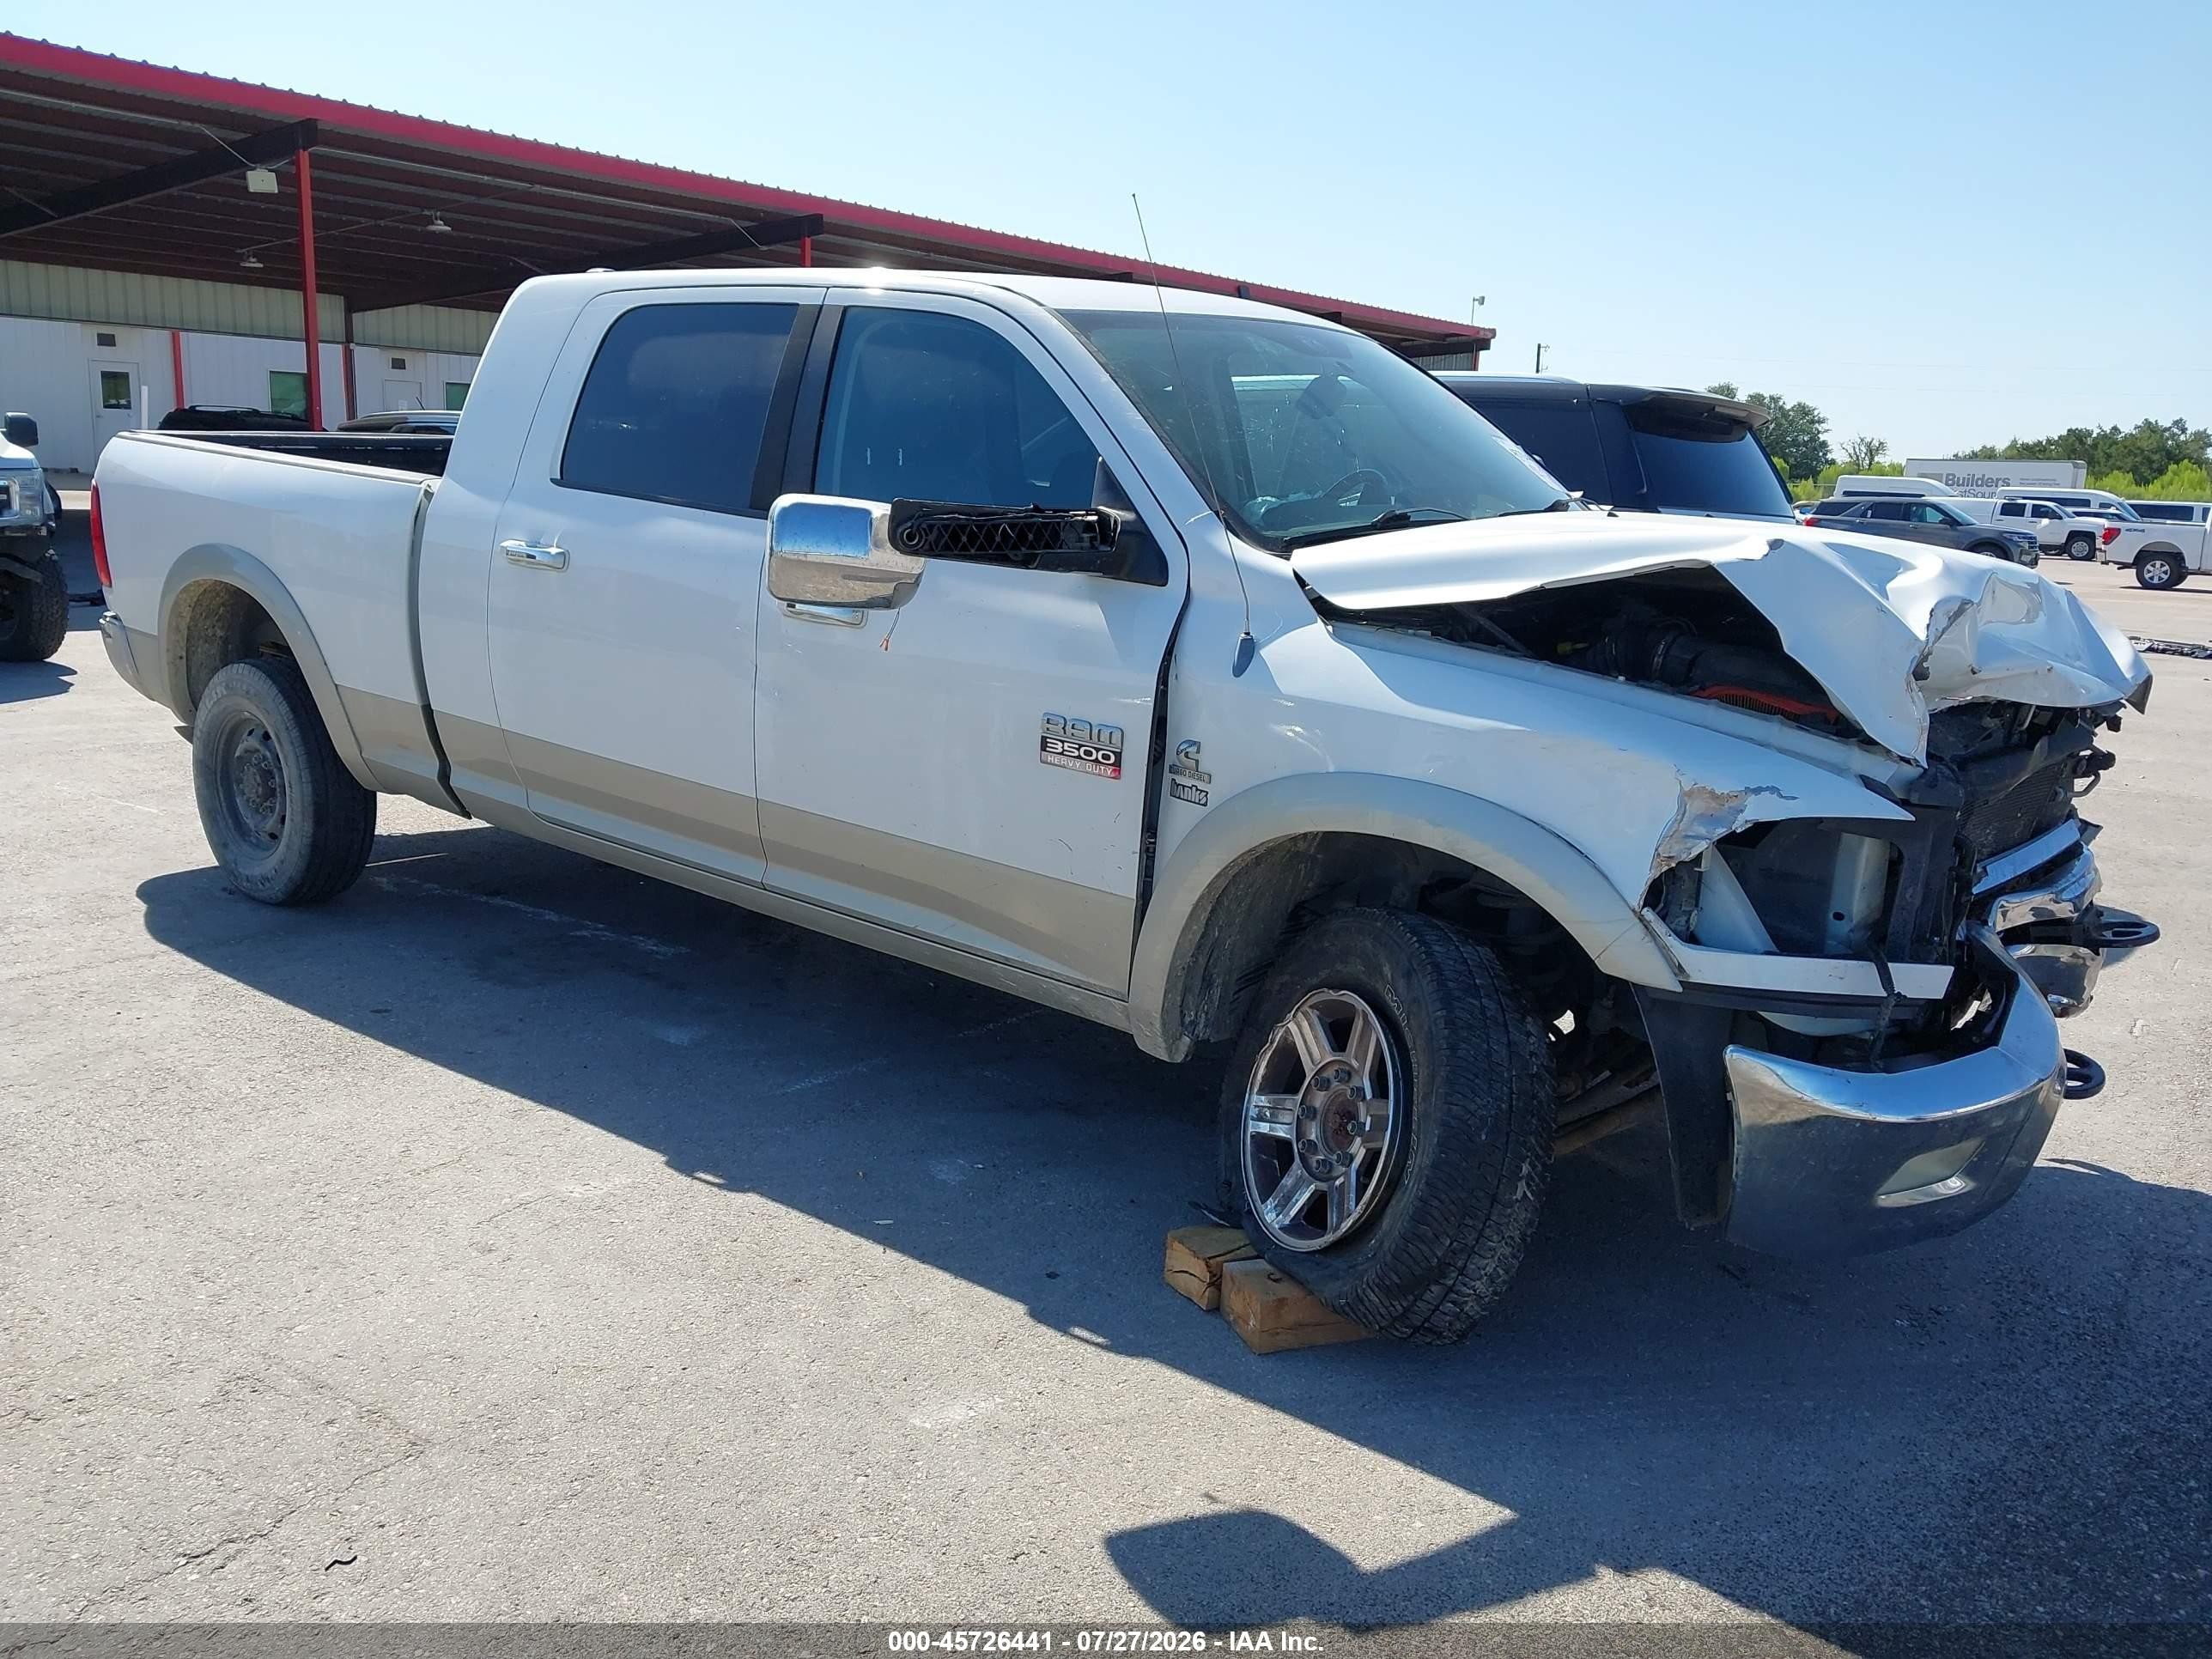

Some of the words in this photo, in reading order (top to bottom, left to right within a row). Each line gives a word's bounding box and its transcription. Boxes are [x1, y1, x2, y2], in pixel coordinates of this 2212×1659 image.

[1945, 473, 2011, 487] Builders
[1042, 712, 1124, 749] RAM
[1046, 738, 1115, 764] 3500
[1048, 755, 1081, 769] HEAVY
[1085, 763, 1113, 776] DUTY
[1385, 984, 1418, 1184] MICHIN
